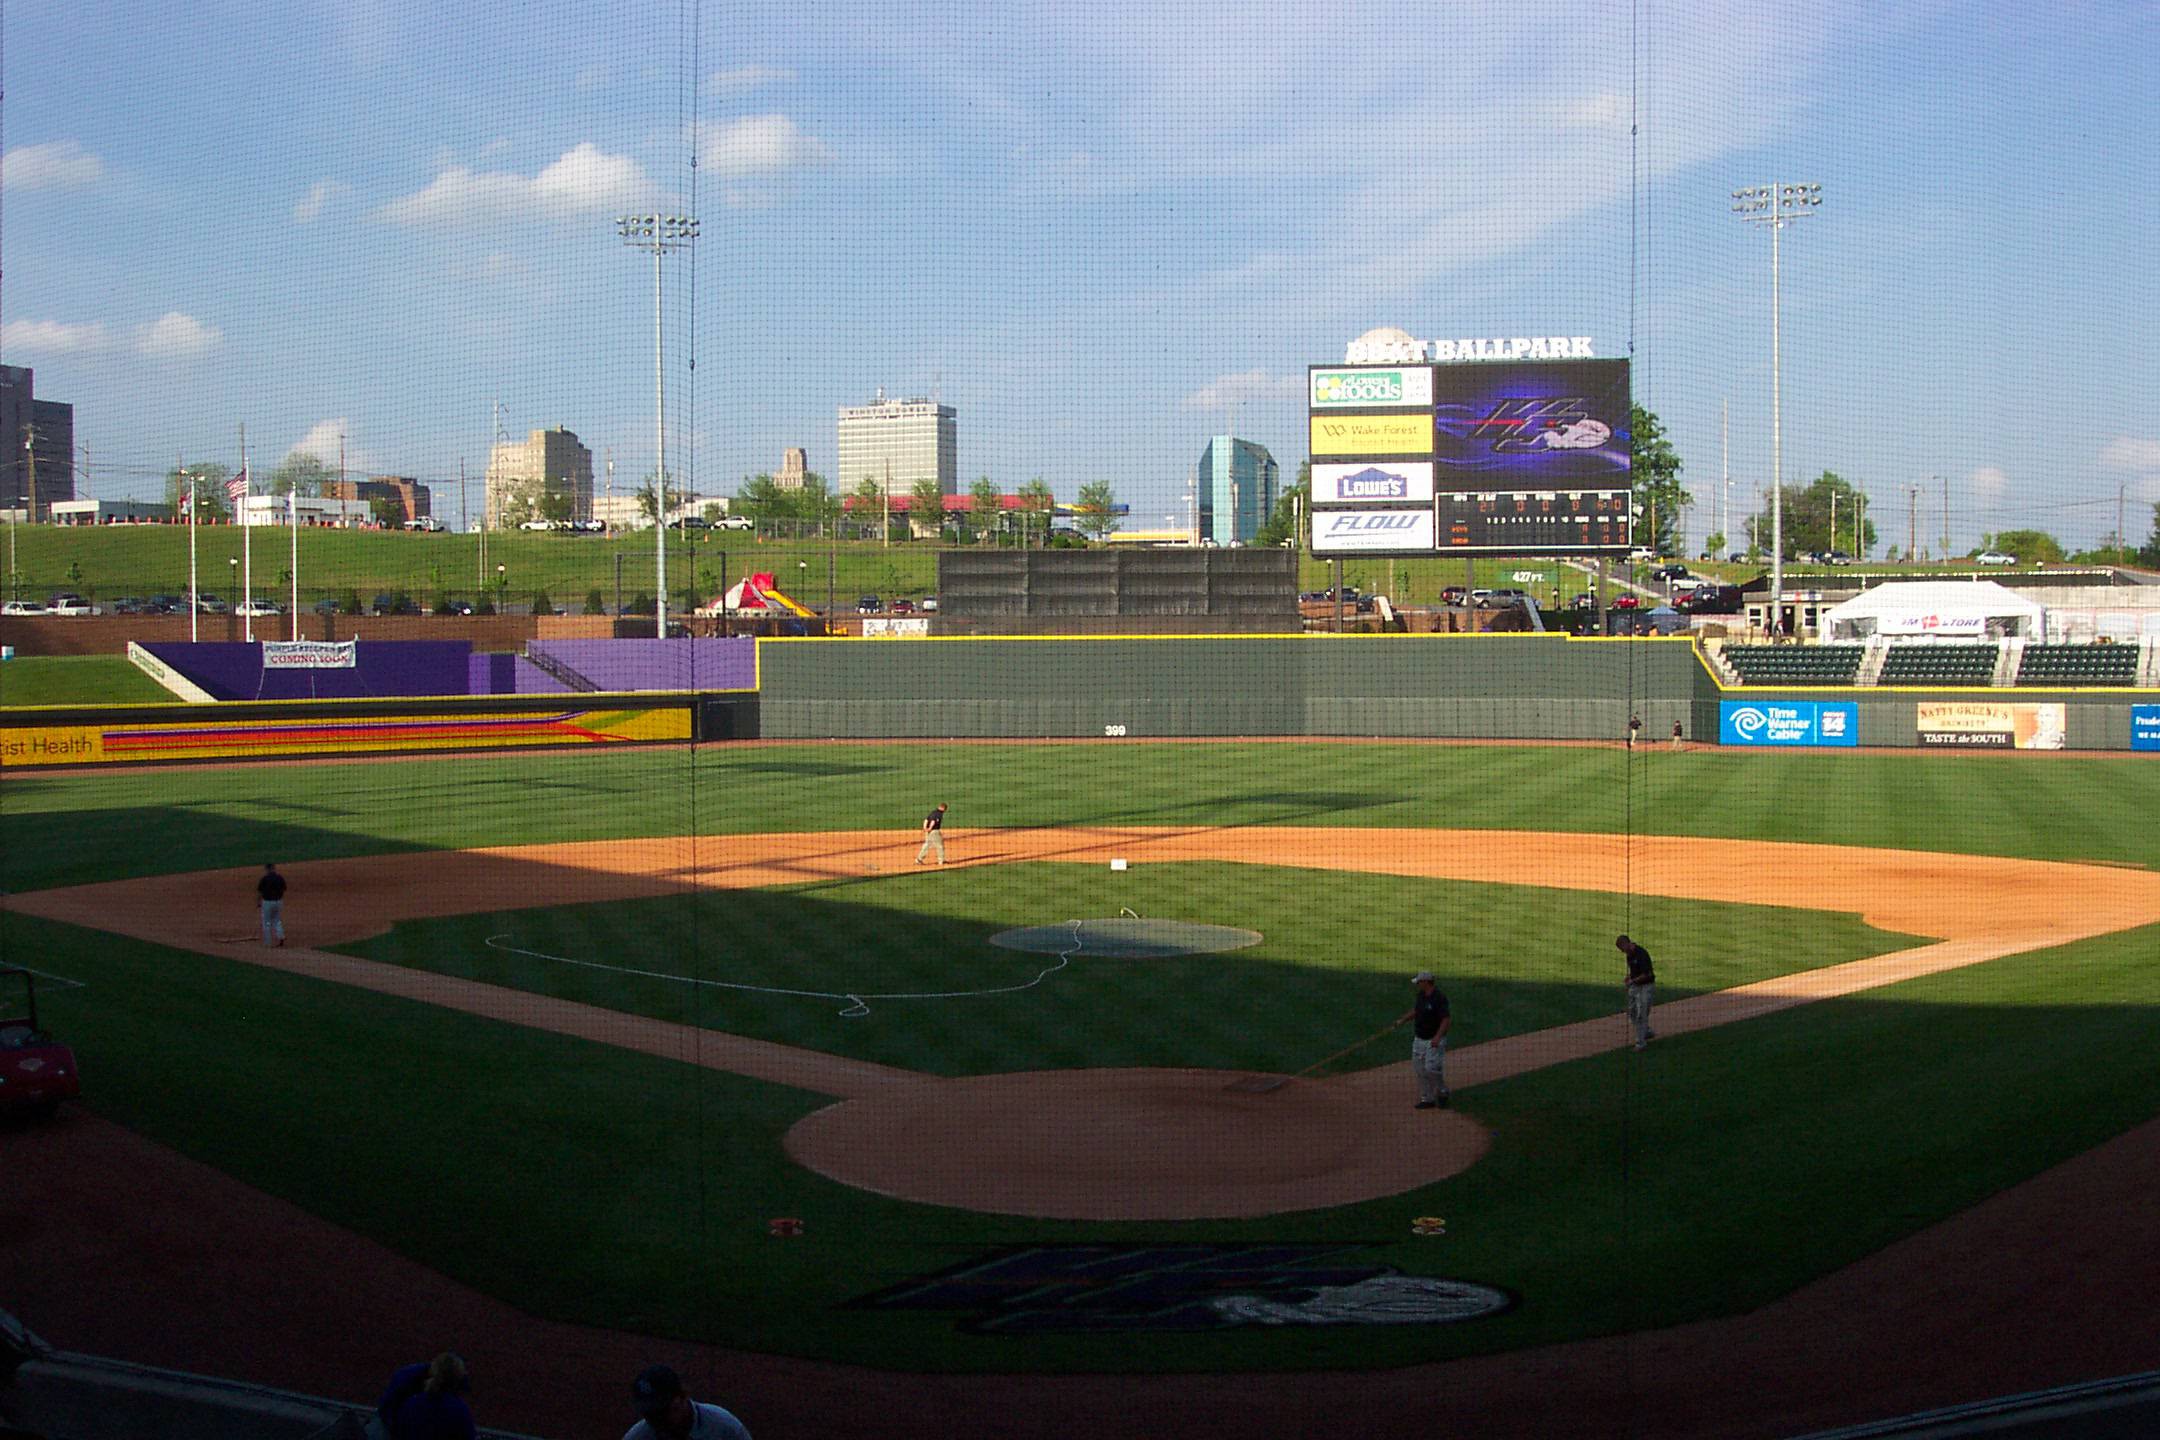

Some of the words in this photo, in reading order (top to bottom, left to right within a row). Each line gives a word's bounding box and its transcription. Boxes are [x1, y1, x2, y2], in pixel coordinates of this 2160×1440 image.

[1435, 337, 1594, 361] BALLPARK
[1351, 425, 1381, 435] Wake
[1383, 424, 1418, 435] Forest
[1343, 479, 1402, 496] LOWE'S
[1331, 515, 1421, 531] FLOW
[1512, 571, 1531, 582] 427
[271, 655, 316, 664] COMING
[1767, 707, 1798, 720] Time
[1920, 707, 1953, 720] NATTY
[1767, 719, 1811, 730] Warner
[1105, 725, 1126, 736] 399
[1767, 729, 1804, 740] Cable
[1924, 733, 1957, 744] TASTE
[1971, 733, 2006, 744] SOUTH
[33, 735, 93, 755] Health
